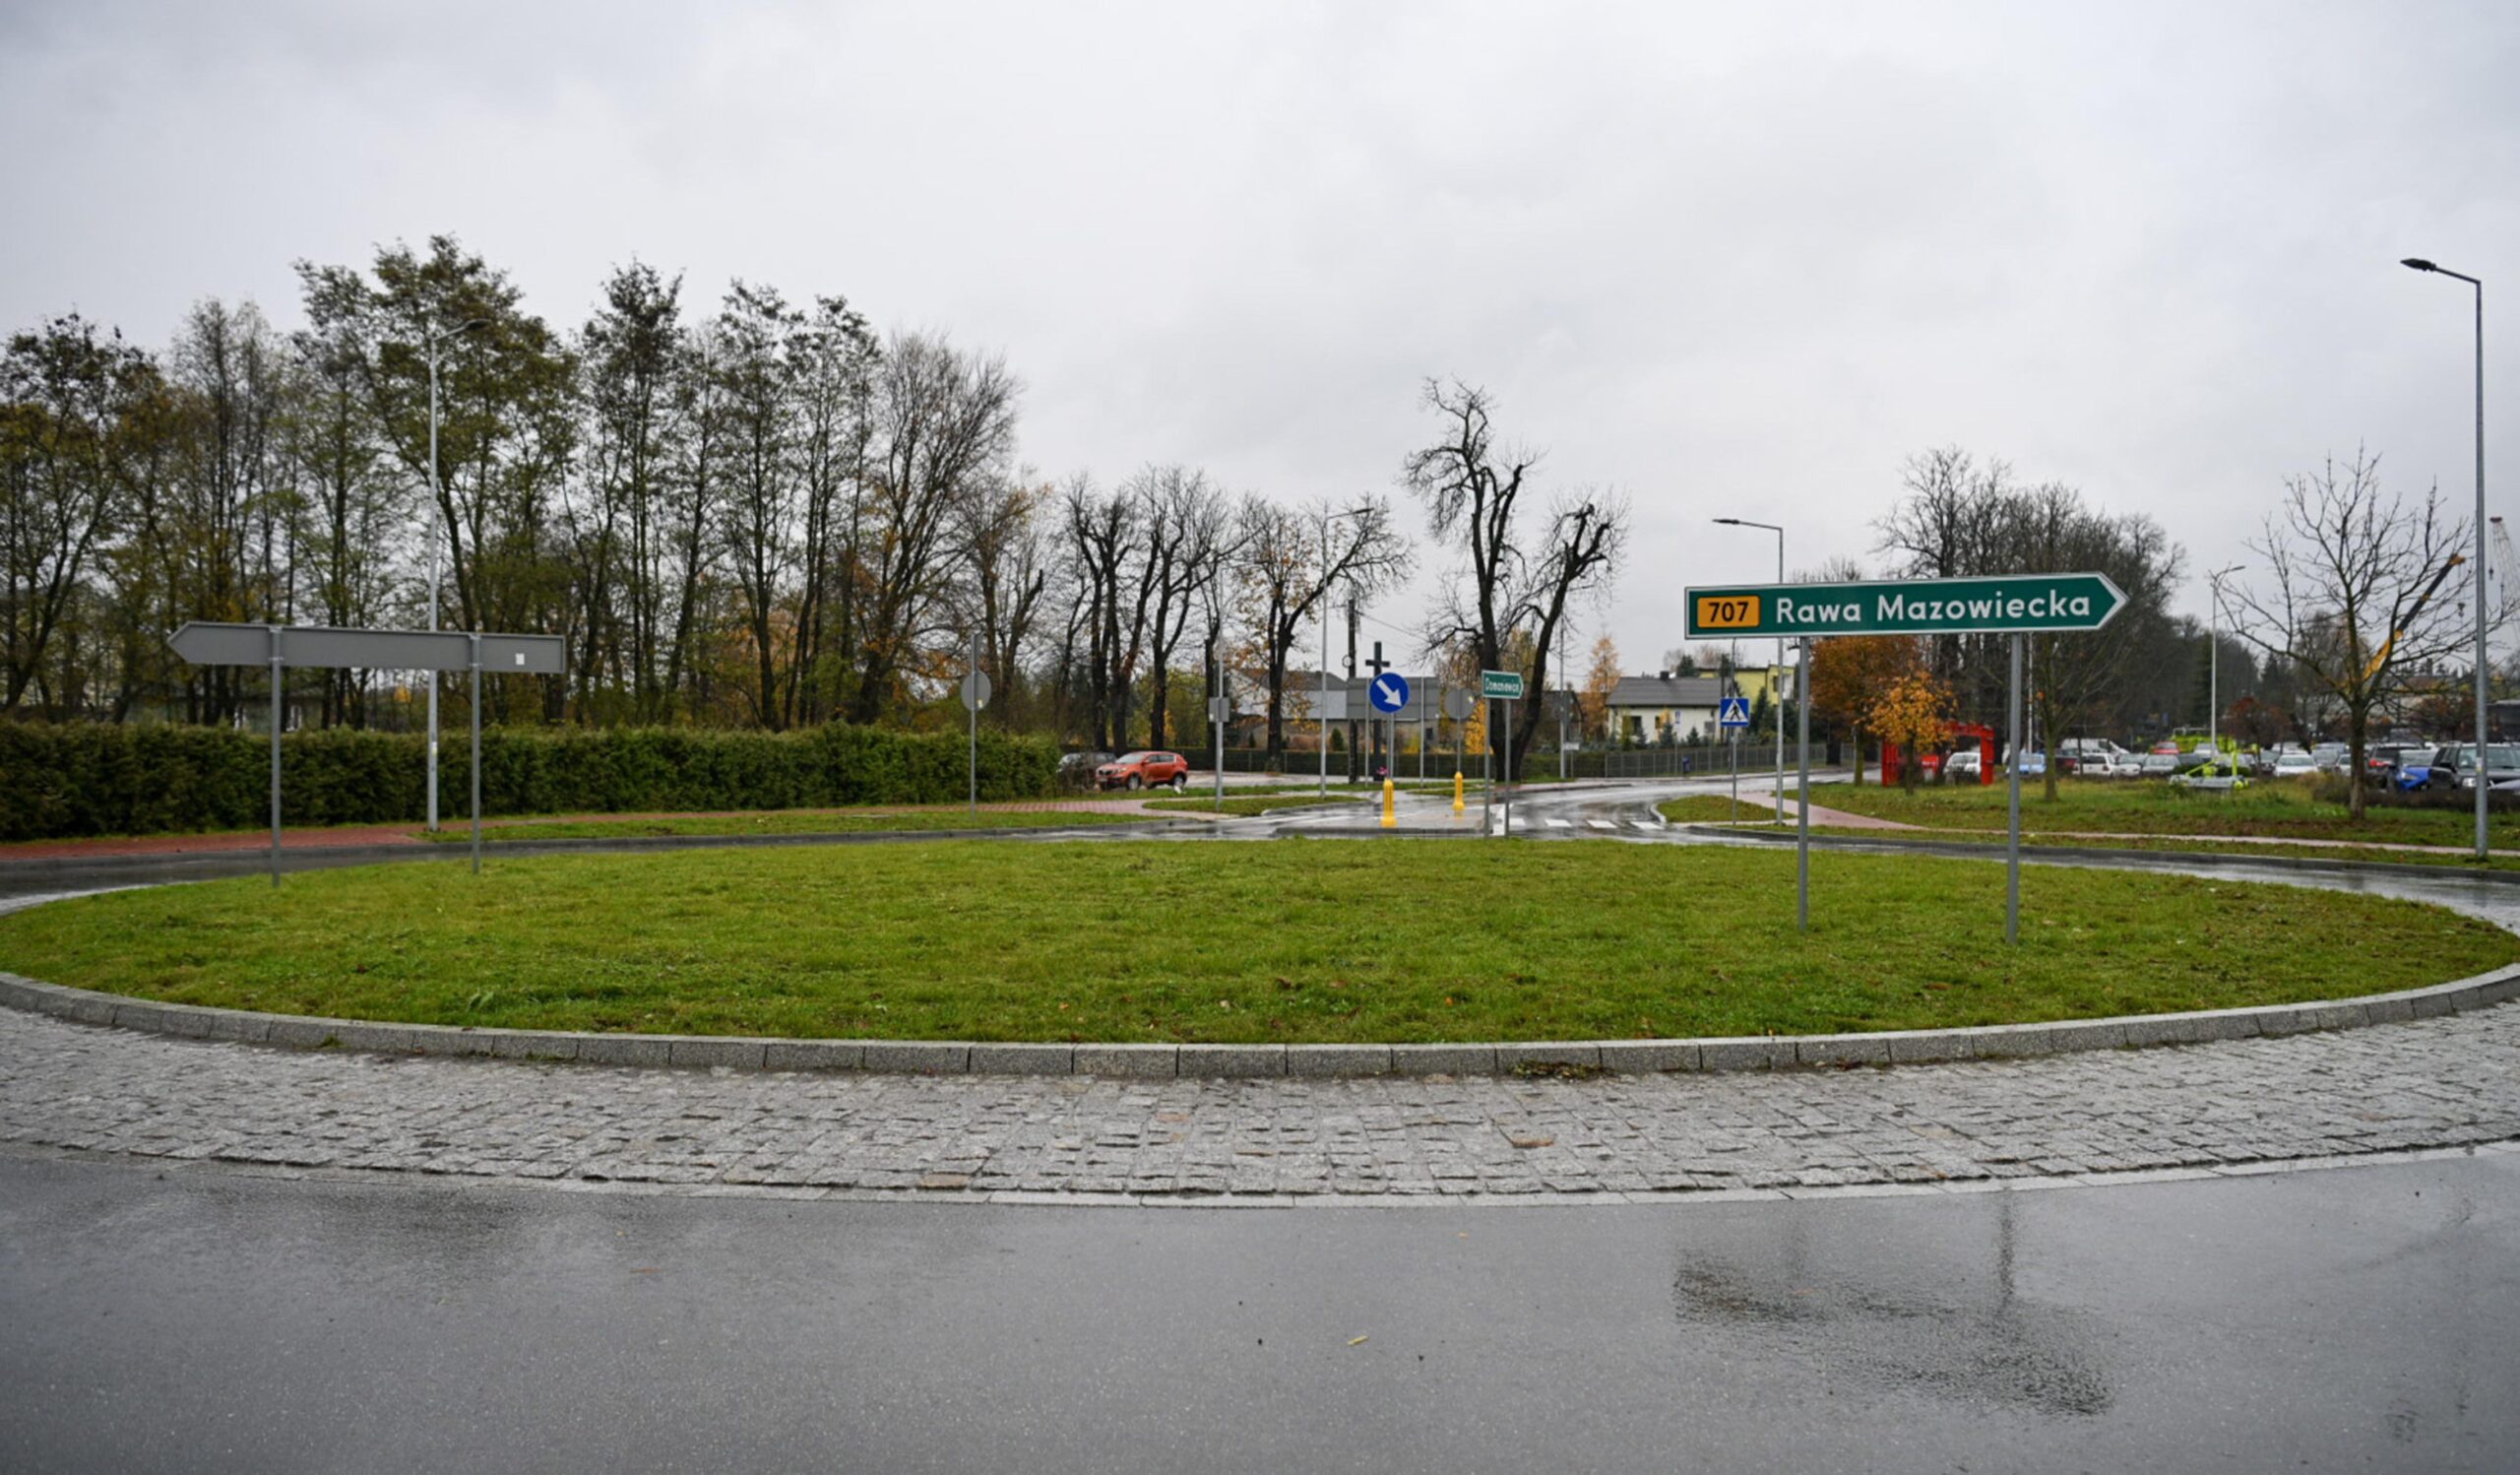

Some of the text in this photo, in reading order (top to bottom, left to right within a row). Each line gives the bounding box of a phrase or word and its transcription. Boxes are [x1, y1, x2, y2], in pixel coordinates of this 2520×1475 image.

[1708, 589, 2091, 623] 707 Rawa Mazowiecka
